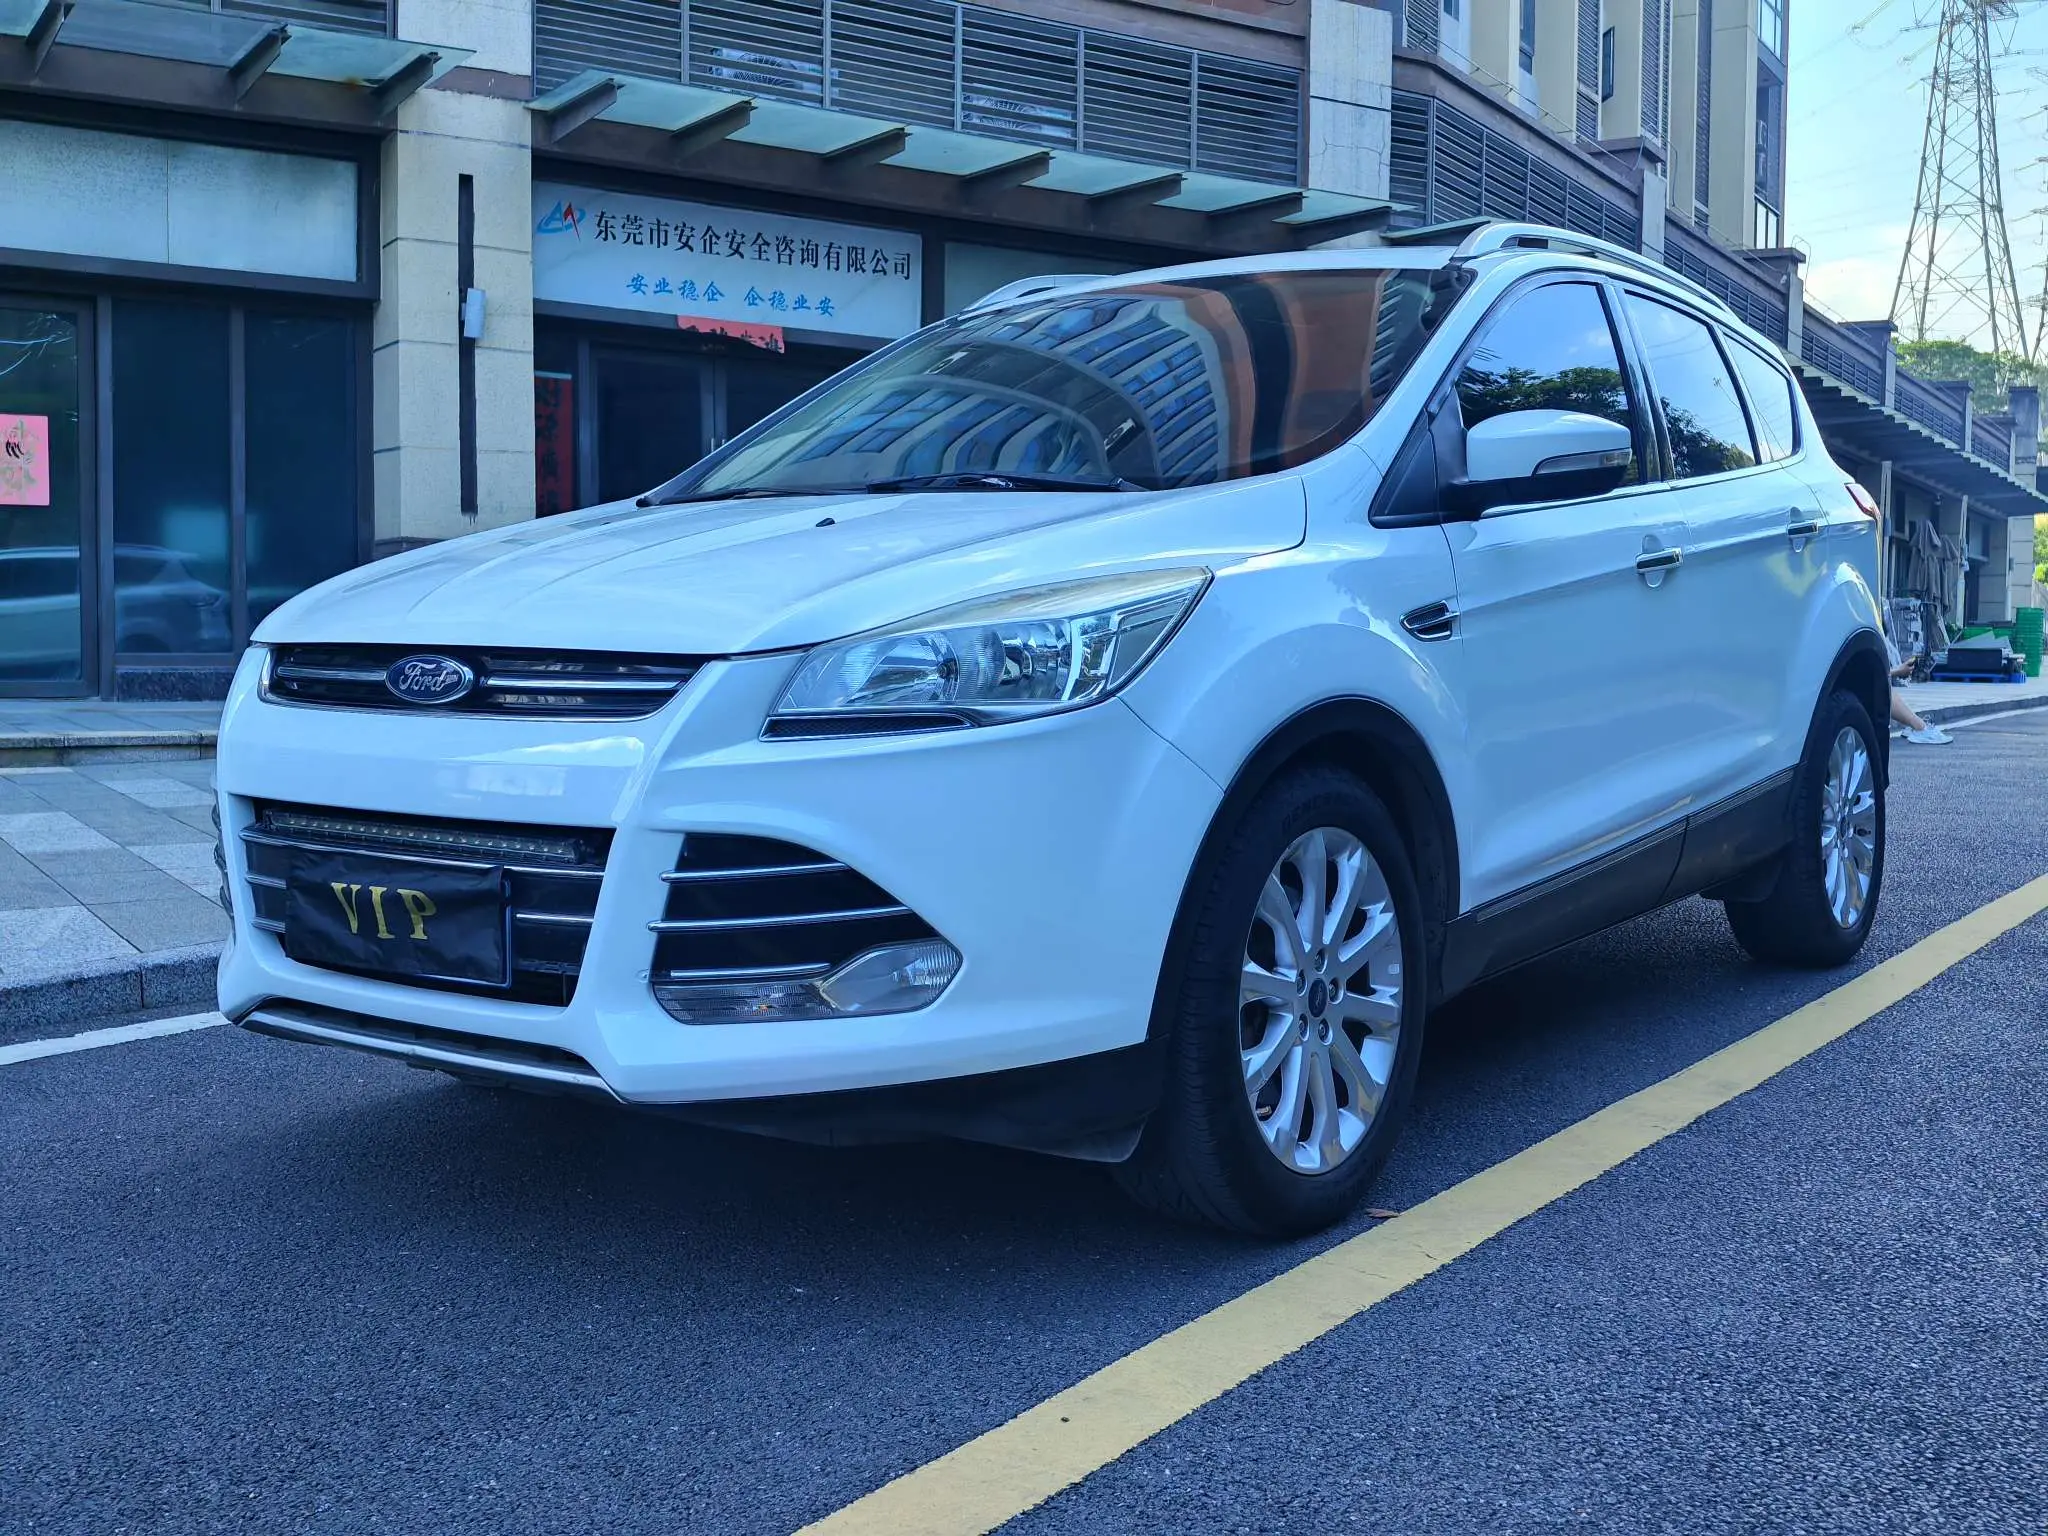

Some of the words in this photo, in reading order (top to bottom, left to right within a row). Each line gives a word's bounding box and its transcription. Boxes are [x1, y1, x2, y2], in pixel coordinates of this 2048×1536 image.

[594, 210, 912, 280] 东莞市安企安全咨询有限公司
[626, 272, 725, 303] 安业稳企
[744, 285, 836, 318] 企稳业安
[399, 662, 458, 691] Ford
[331, 882, 438, 940] VIP
